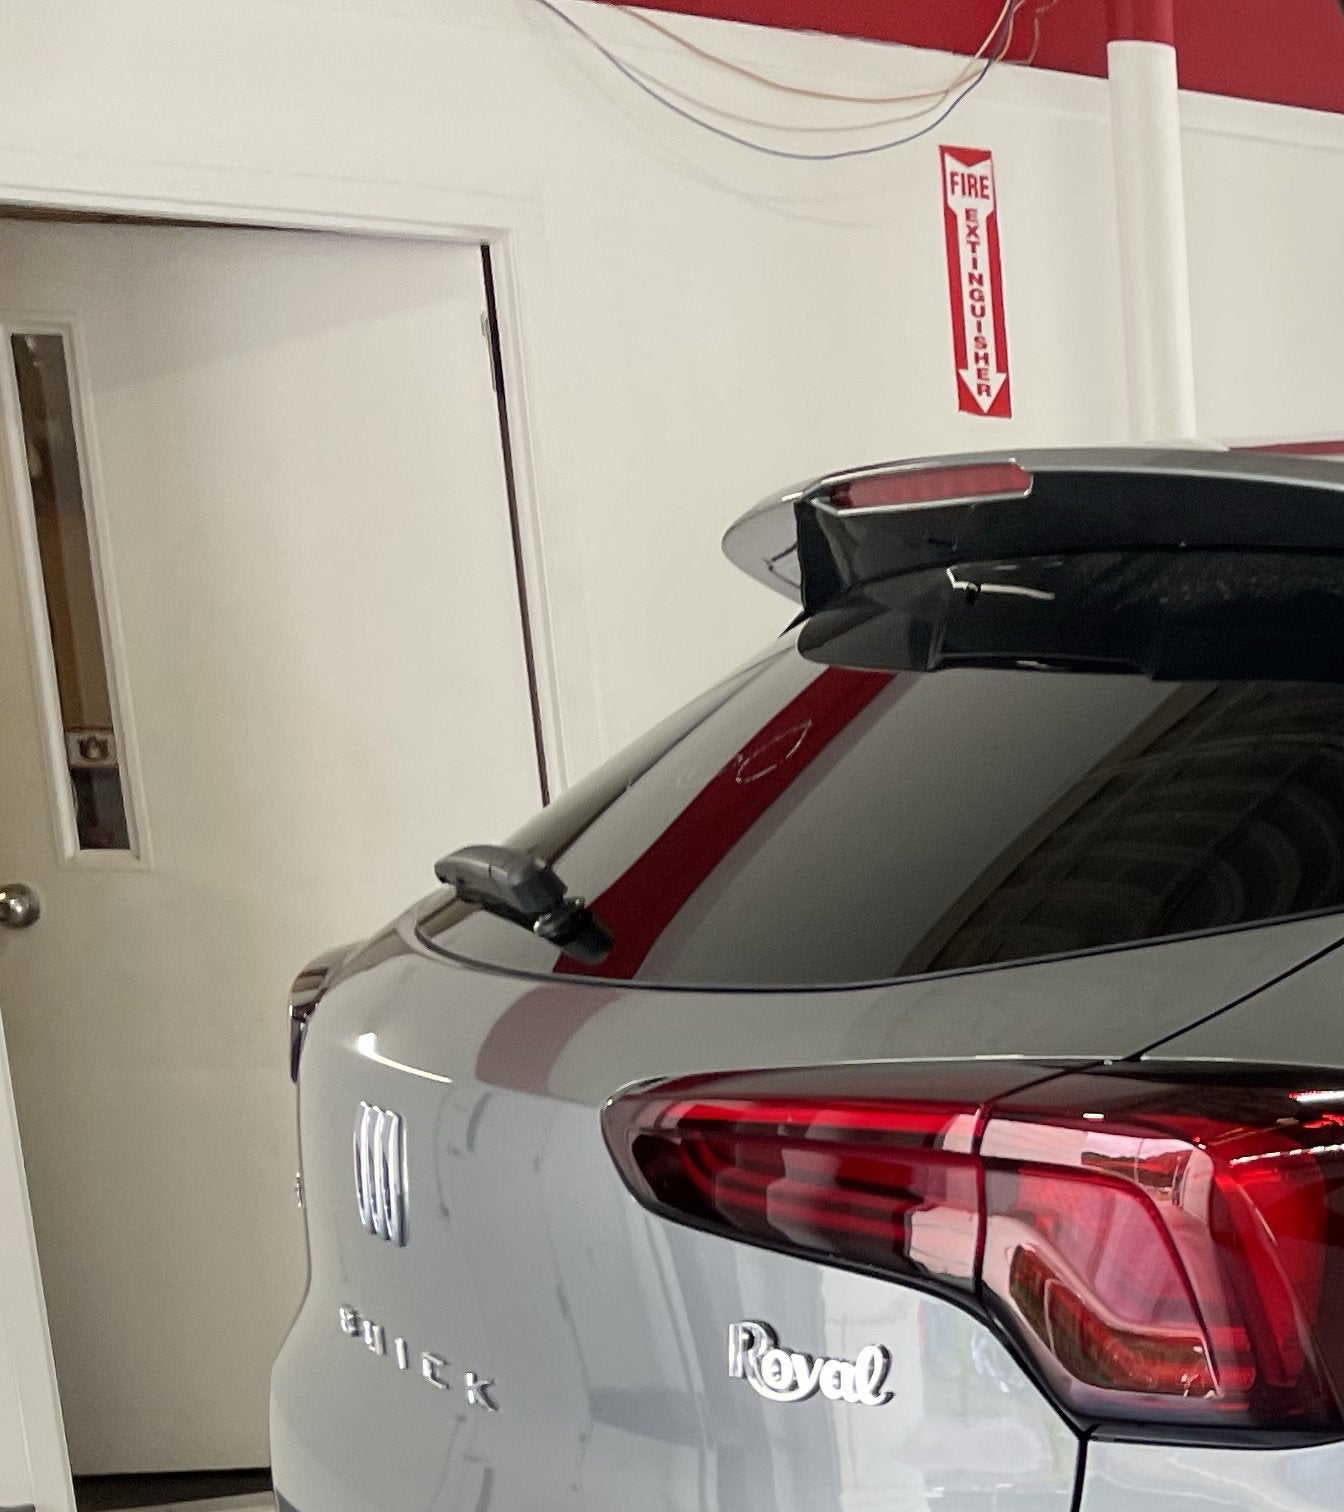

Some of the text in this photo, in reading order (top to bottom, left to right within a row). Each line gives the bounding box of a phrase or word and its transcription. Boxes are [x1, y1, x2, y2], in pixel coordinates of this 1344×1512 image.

[949, 170, 990, 200] FIRE
[964, 208, 991, 397] EXTINGUISHER
[338, 1303, 499, 1412] BUICK
[728, 1318, 895, 1406] Royal
